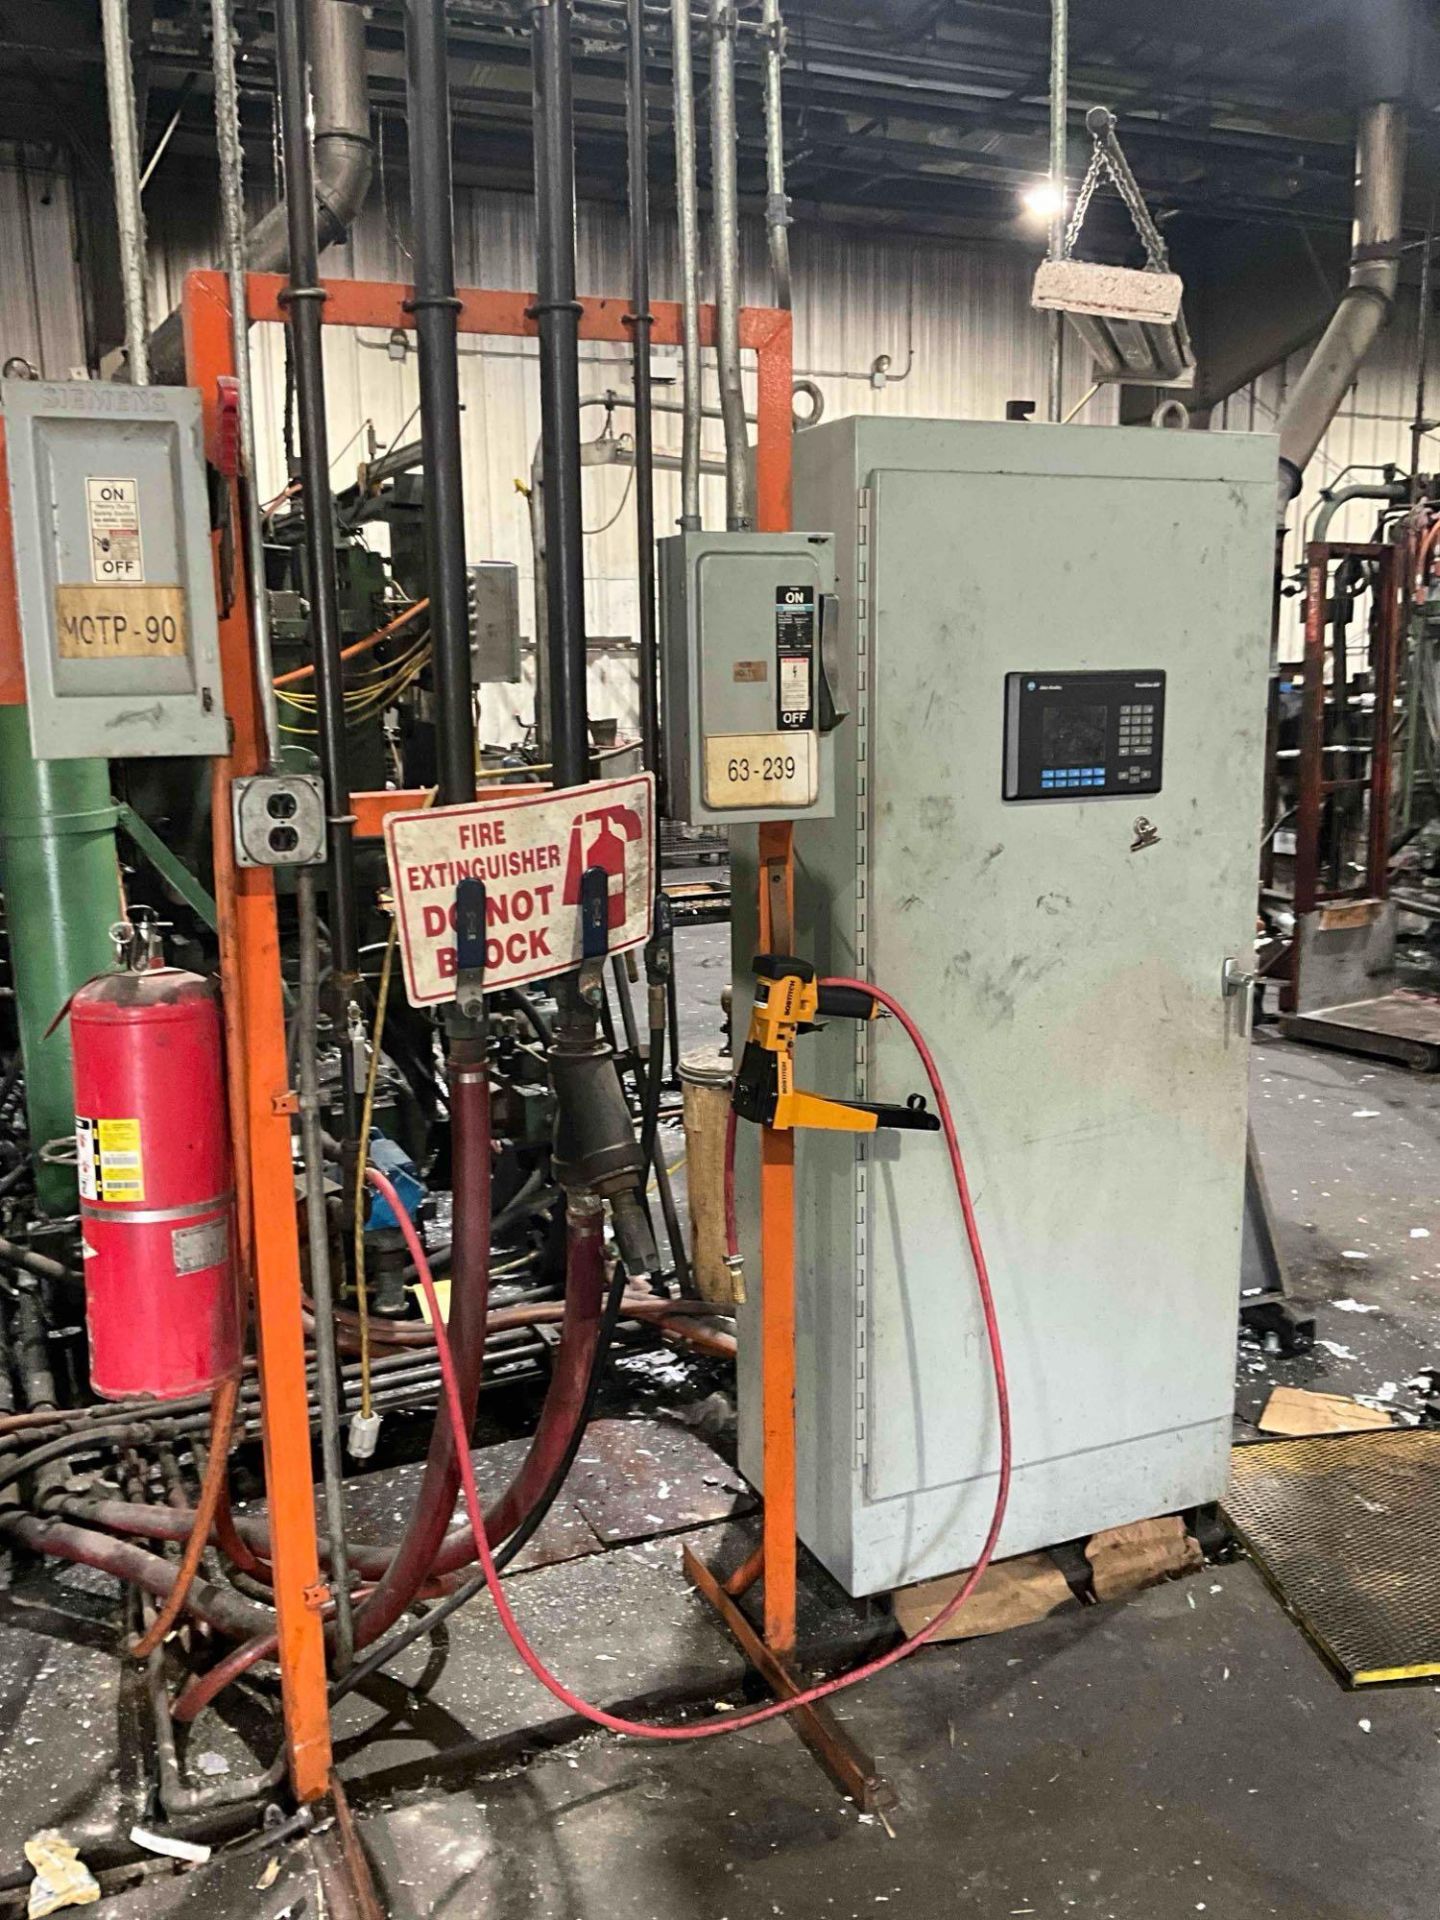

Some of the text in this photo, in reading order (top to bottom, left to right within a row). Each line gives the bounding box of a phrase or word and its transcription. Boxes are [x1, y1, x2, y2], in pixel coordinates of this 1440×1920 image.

[43, 387, 167, 412] SIEMENS
[100, 487, 125, 501] ON
[102, 560, 134, 574] OFF
[786, 592, 804, 603] ON
[783, 712, 807, 723] OFF
[728, 756, 796, 782] 63-239
[459, 821, 506, 849] FIRE
[407, 845, 560, 891] EXTINGUISHER
[485, 885, 554, 926] NOT
[437, 927, 551, 978] BOCK
[784, 980, 795, 1016] BOSTITCH
